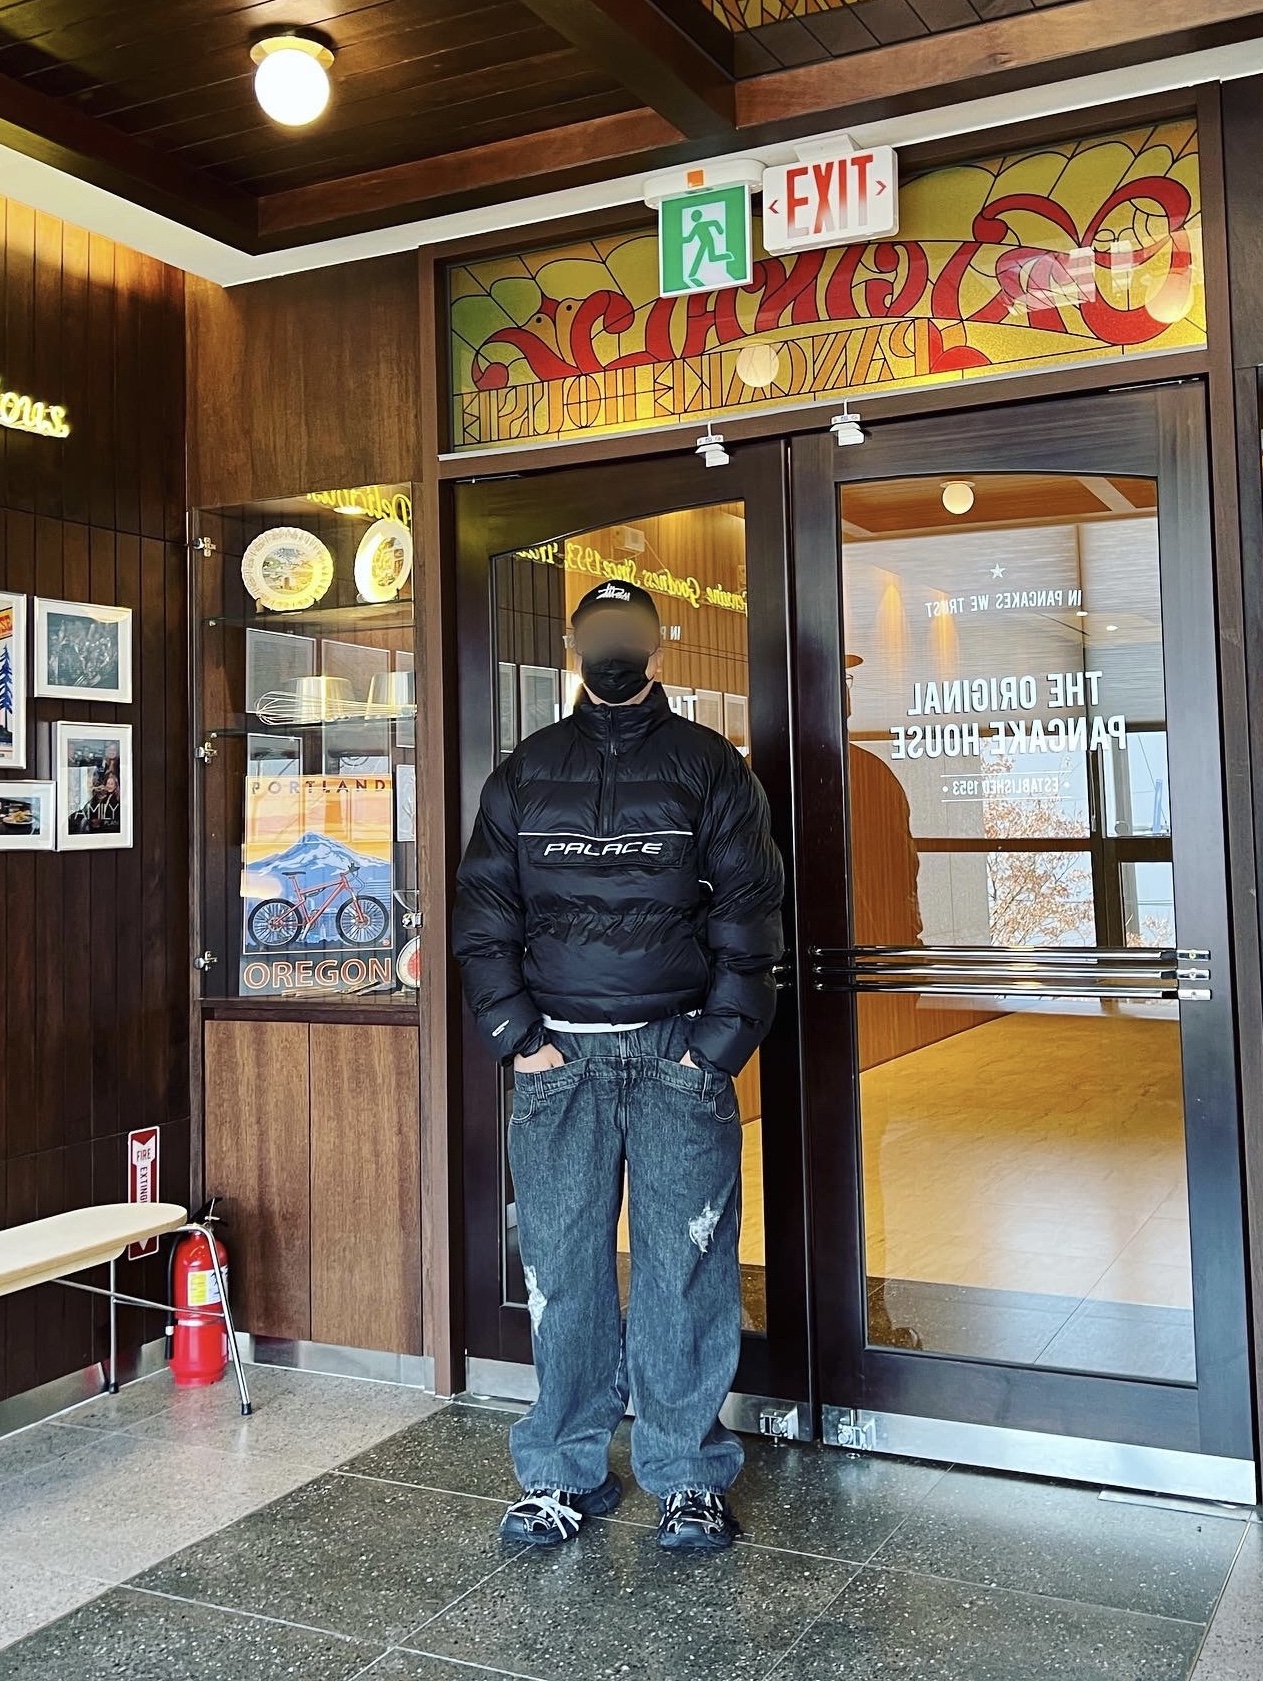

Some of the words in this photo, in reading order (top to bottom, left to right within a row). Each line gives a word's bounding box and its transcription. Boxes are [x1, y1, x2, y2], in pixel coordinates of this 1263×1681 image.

[785, 153, 875, 240] EXIT
[251, 779, 386, 795] PORTLAND
[543, 841, 664, 857] PALACE
[243, 957, 392, 990] OREGON
[136, 1149, 151, 1162] FIRE
[139, 1166, 148, 1204] EXTING
